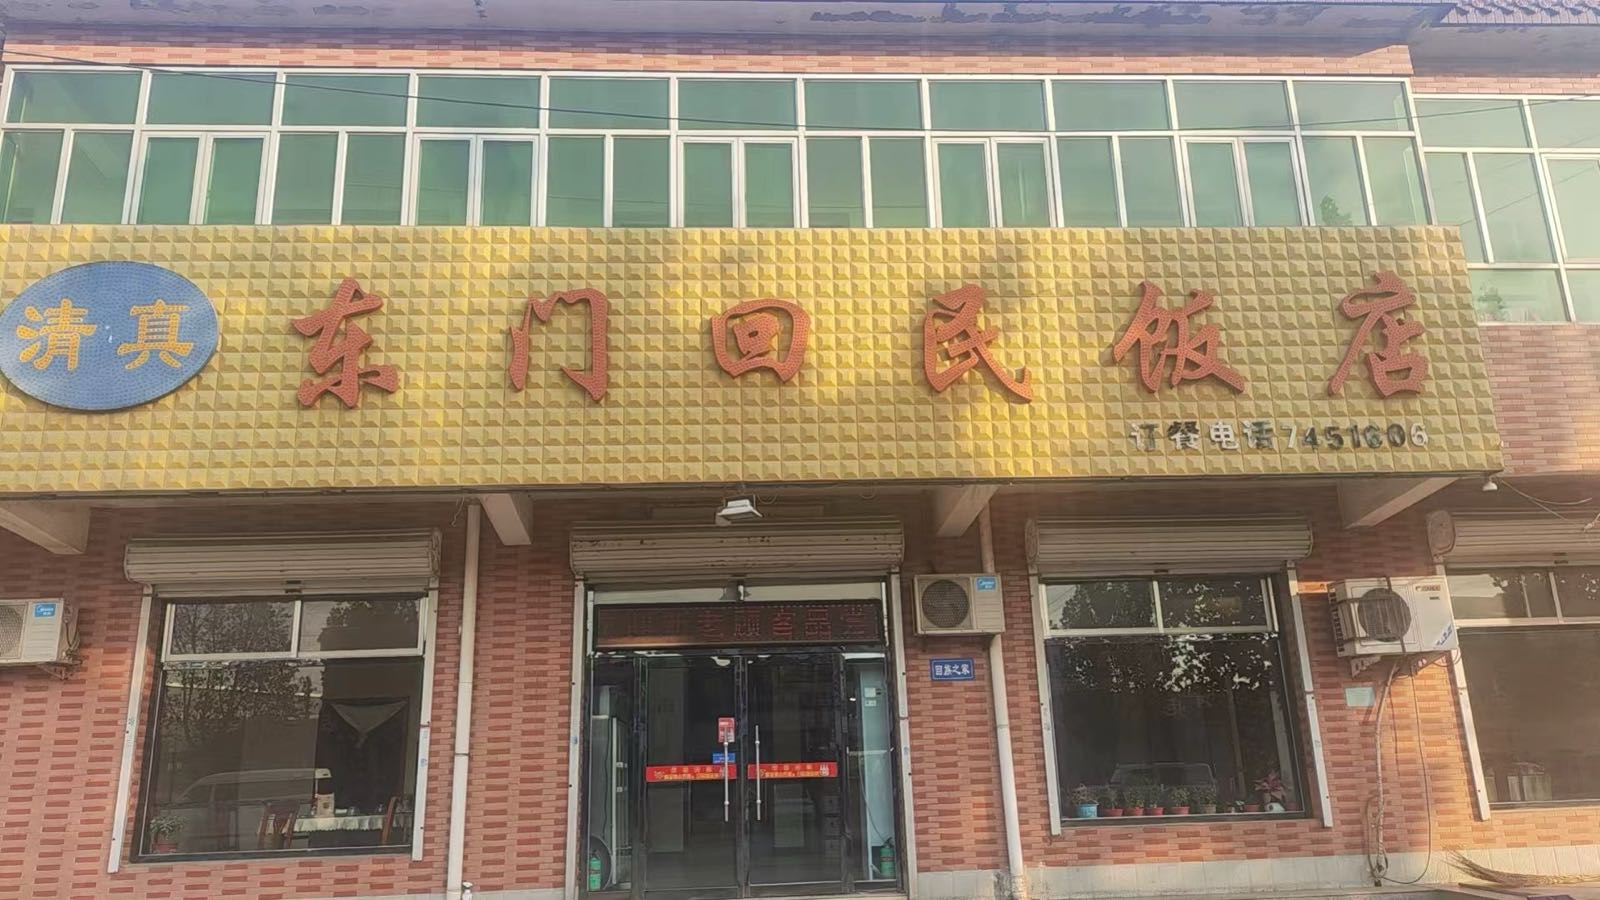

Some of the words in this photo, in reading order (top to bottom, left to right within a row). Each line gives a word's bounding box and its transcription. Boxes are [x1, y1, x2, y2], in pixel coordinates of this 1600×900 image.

[17, 297, 194, 372] 清真
[292, 271, 1429, 409] 东门回民饭店
